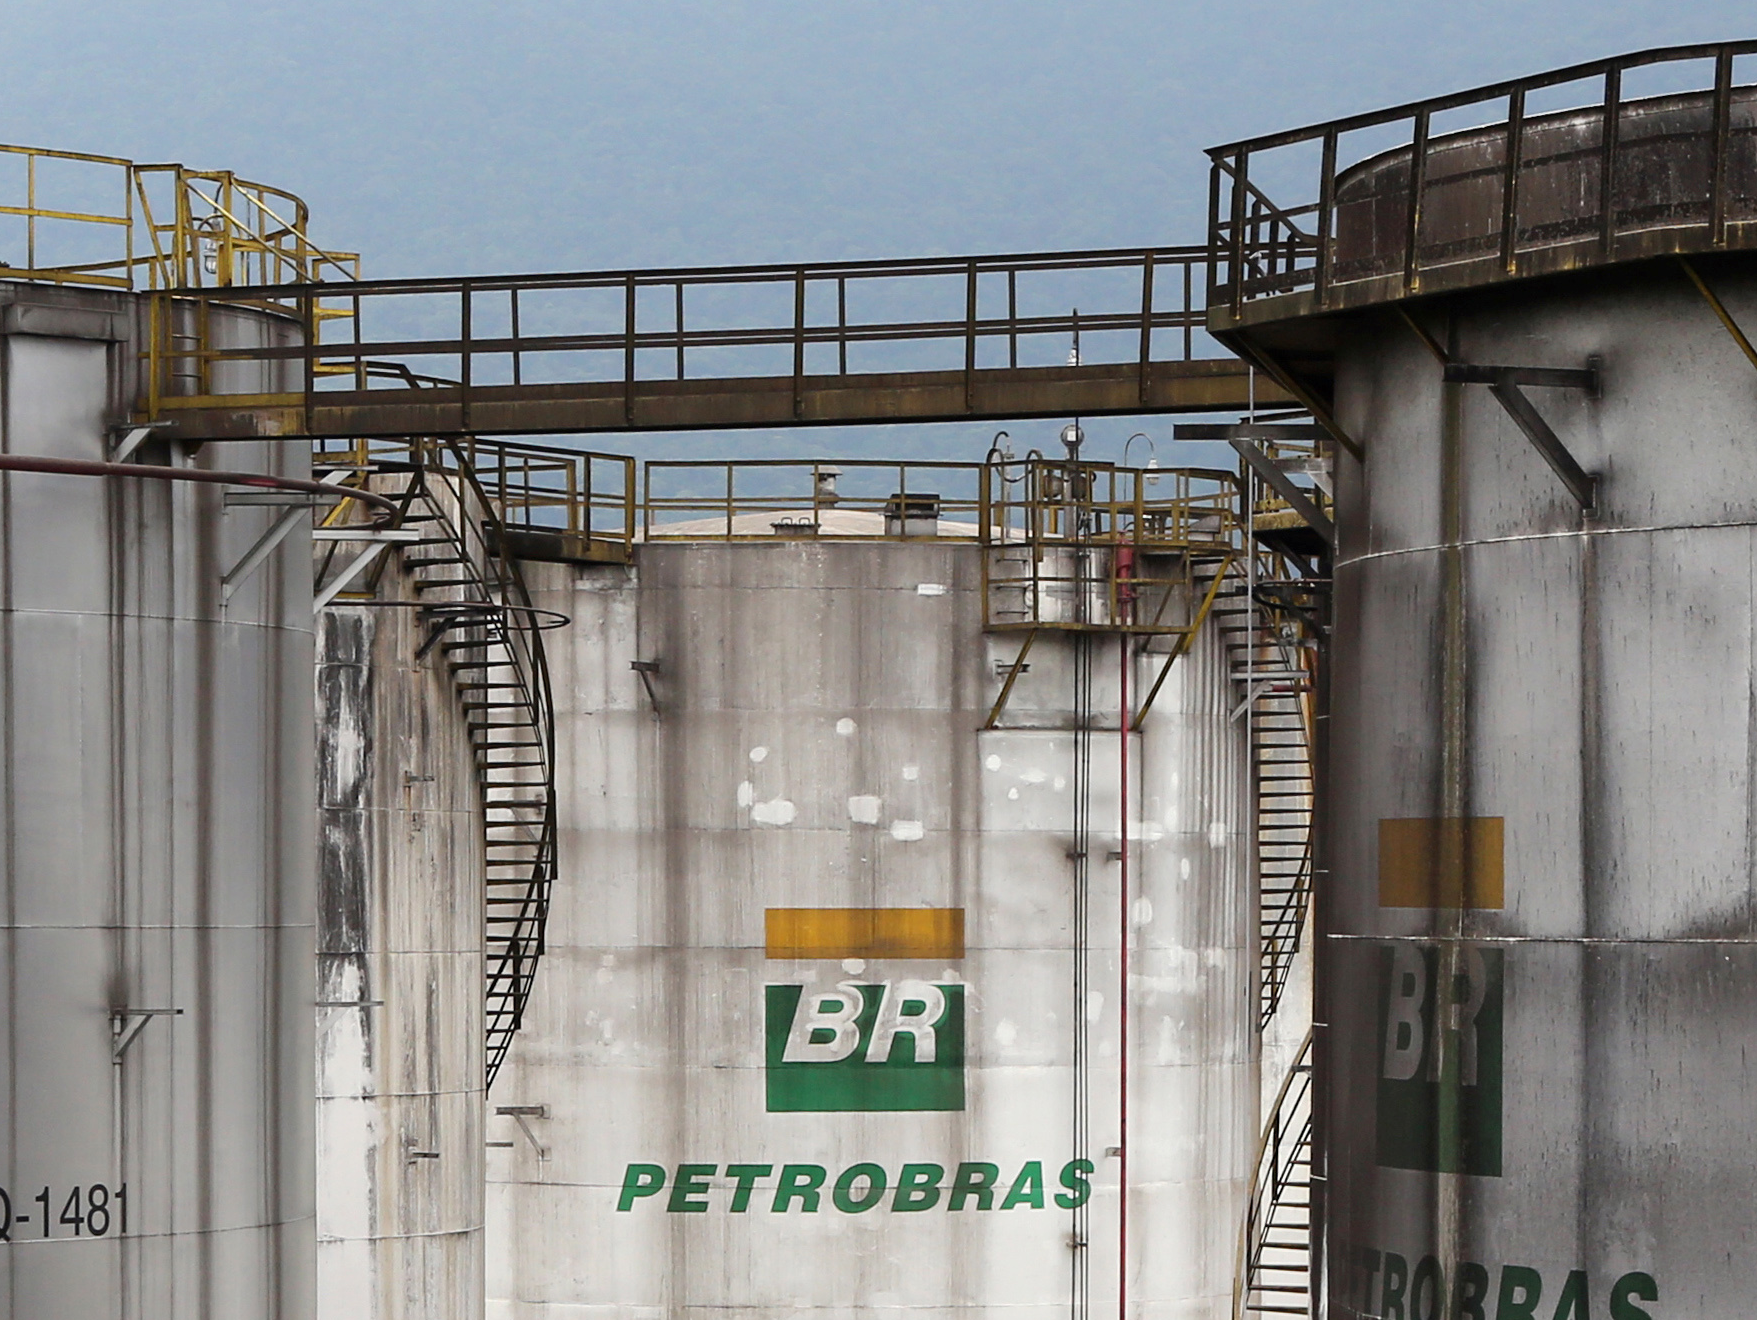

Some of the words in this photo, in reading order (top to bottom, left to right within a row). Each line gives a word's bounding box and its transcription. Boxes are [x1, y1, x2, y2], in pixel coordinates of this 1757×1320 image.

[781, 981, 946, 1063] BR
[1383, 944, 1486, 1086] BR
[616, 1158, 1095, 1214] PETROBRAS
